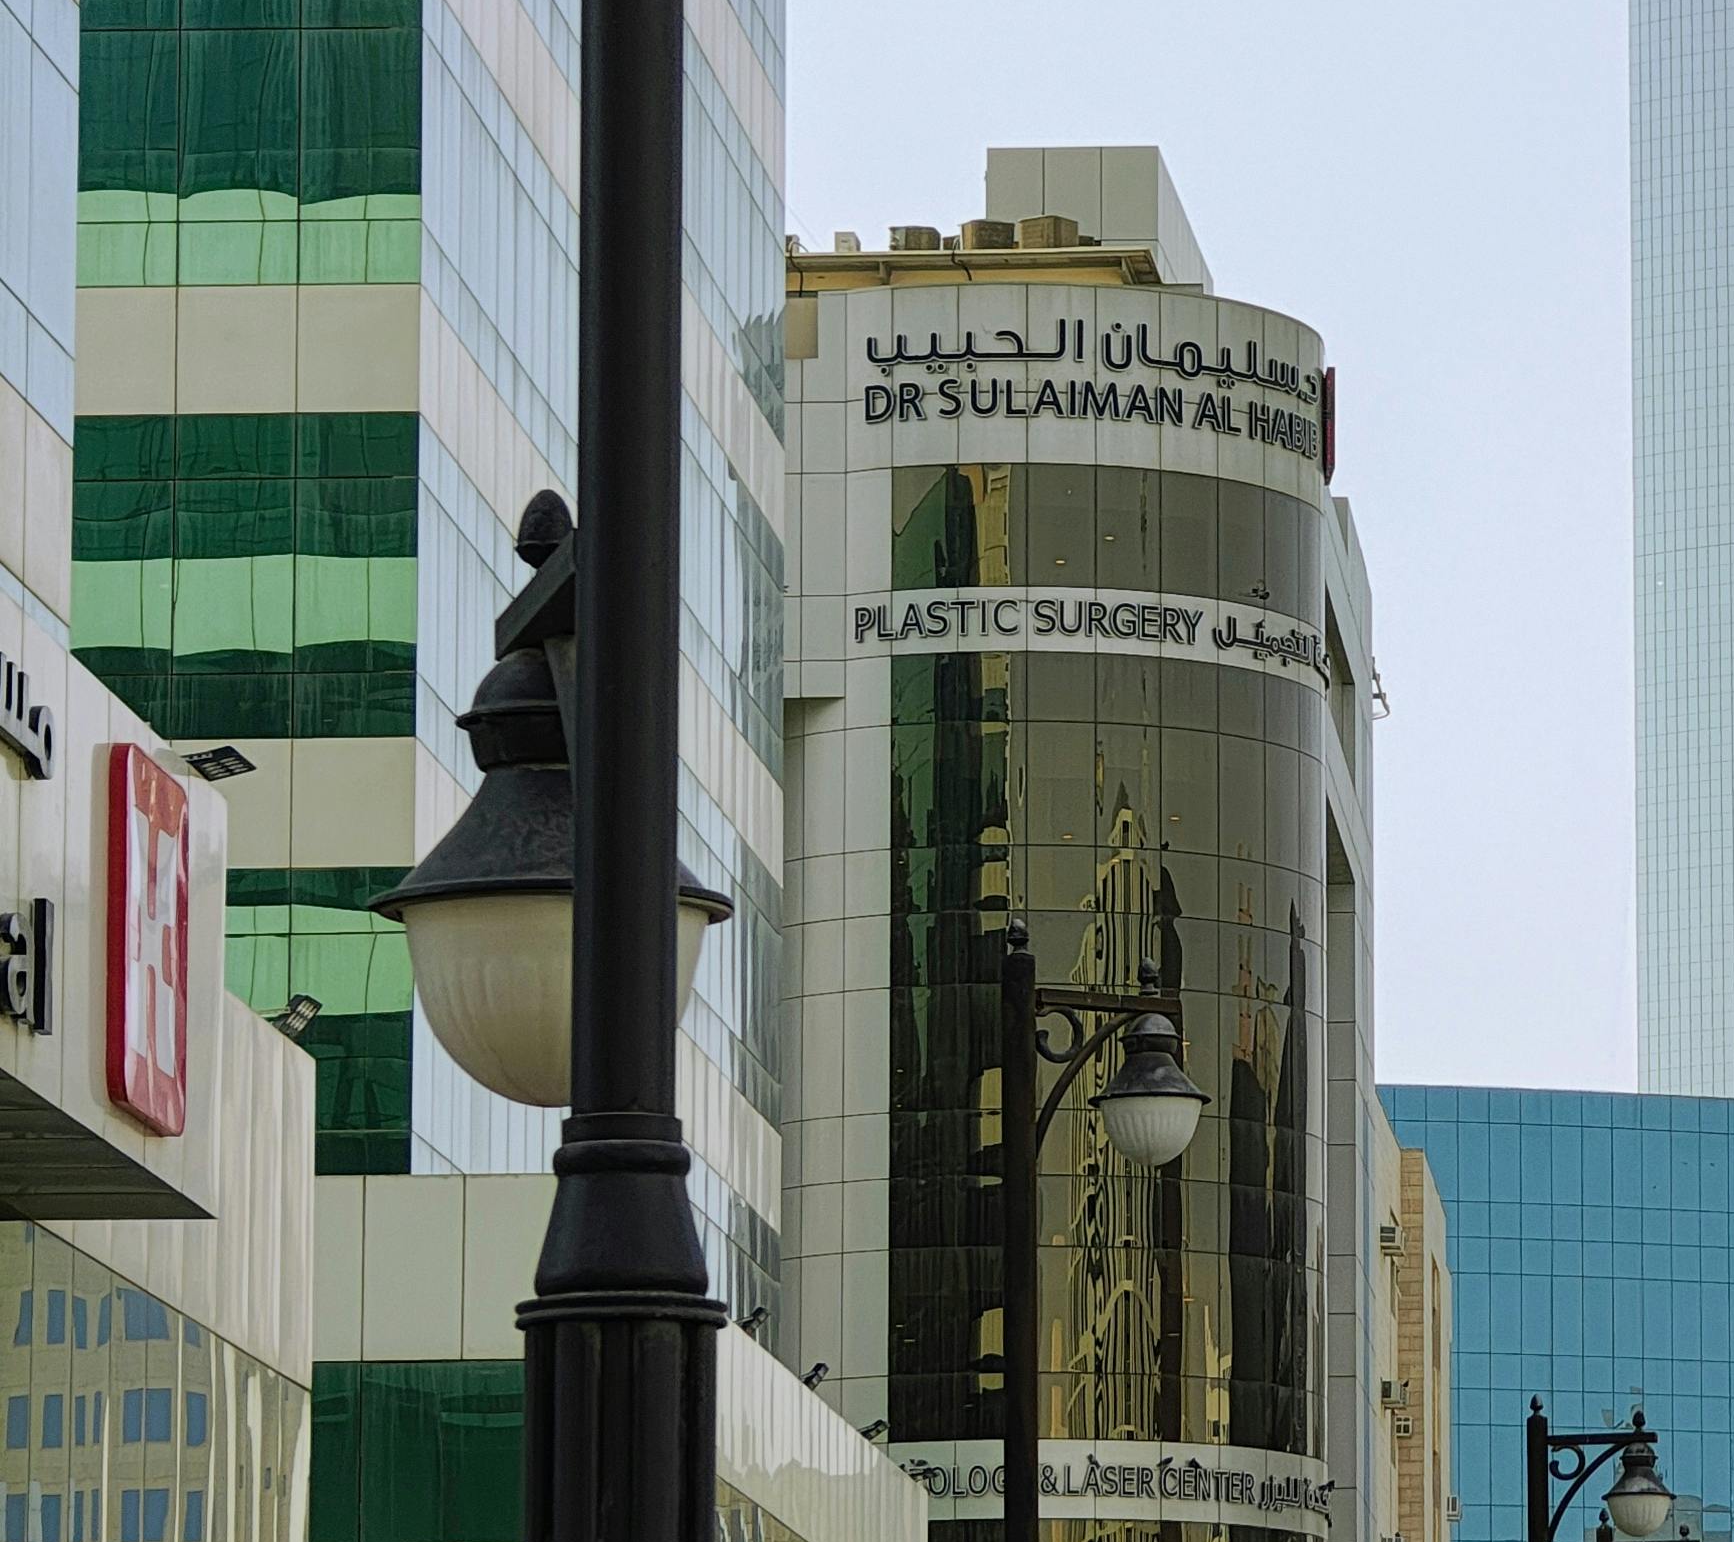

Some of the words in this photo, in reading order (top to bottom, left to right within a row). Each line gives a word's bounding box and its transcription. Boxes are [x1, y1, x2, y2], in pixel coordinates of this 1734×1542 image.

[867, 318, 1084, 376] الحبيب
[1103, 322, 1320, 403] د.سليمان
[865, 383, 926, 422] DR
[938, 378, 1183, 427] SULAIMAN
[1195, 390, 1241, 436] AL
[1249, 399, 1322, 460] HABIB
[854, 599, 1021, 643] PLASTIC
[1033, 598, 1203, 646] SURGERY
[1041, 1465, 1060, 1496] &
[1063, 1464, 1156, 1499] LASER
[1160, 1466, 1256, 1505] CENTER
